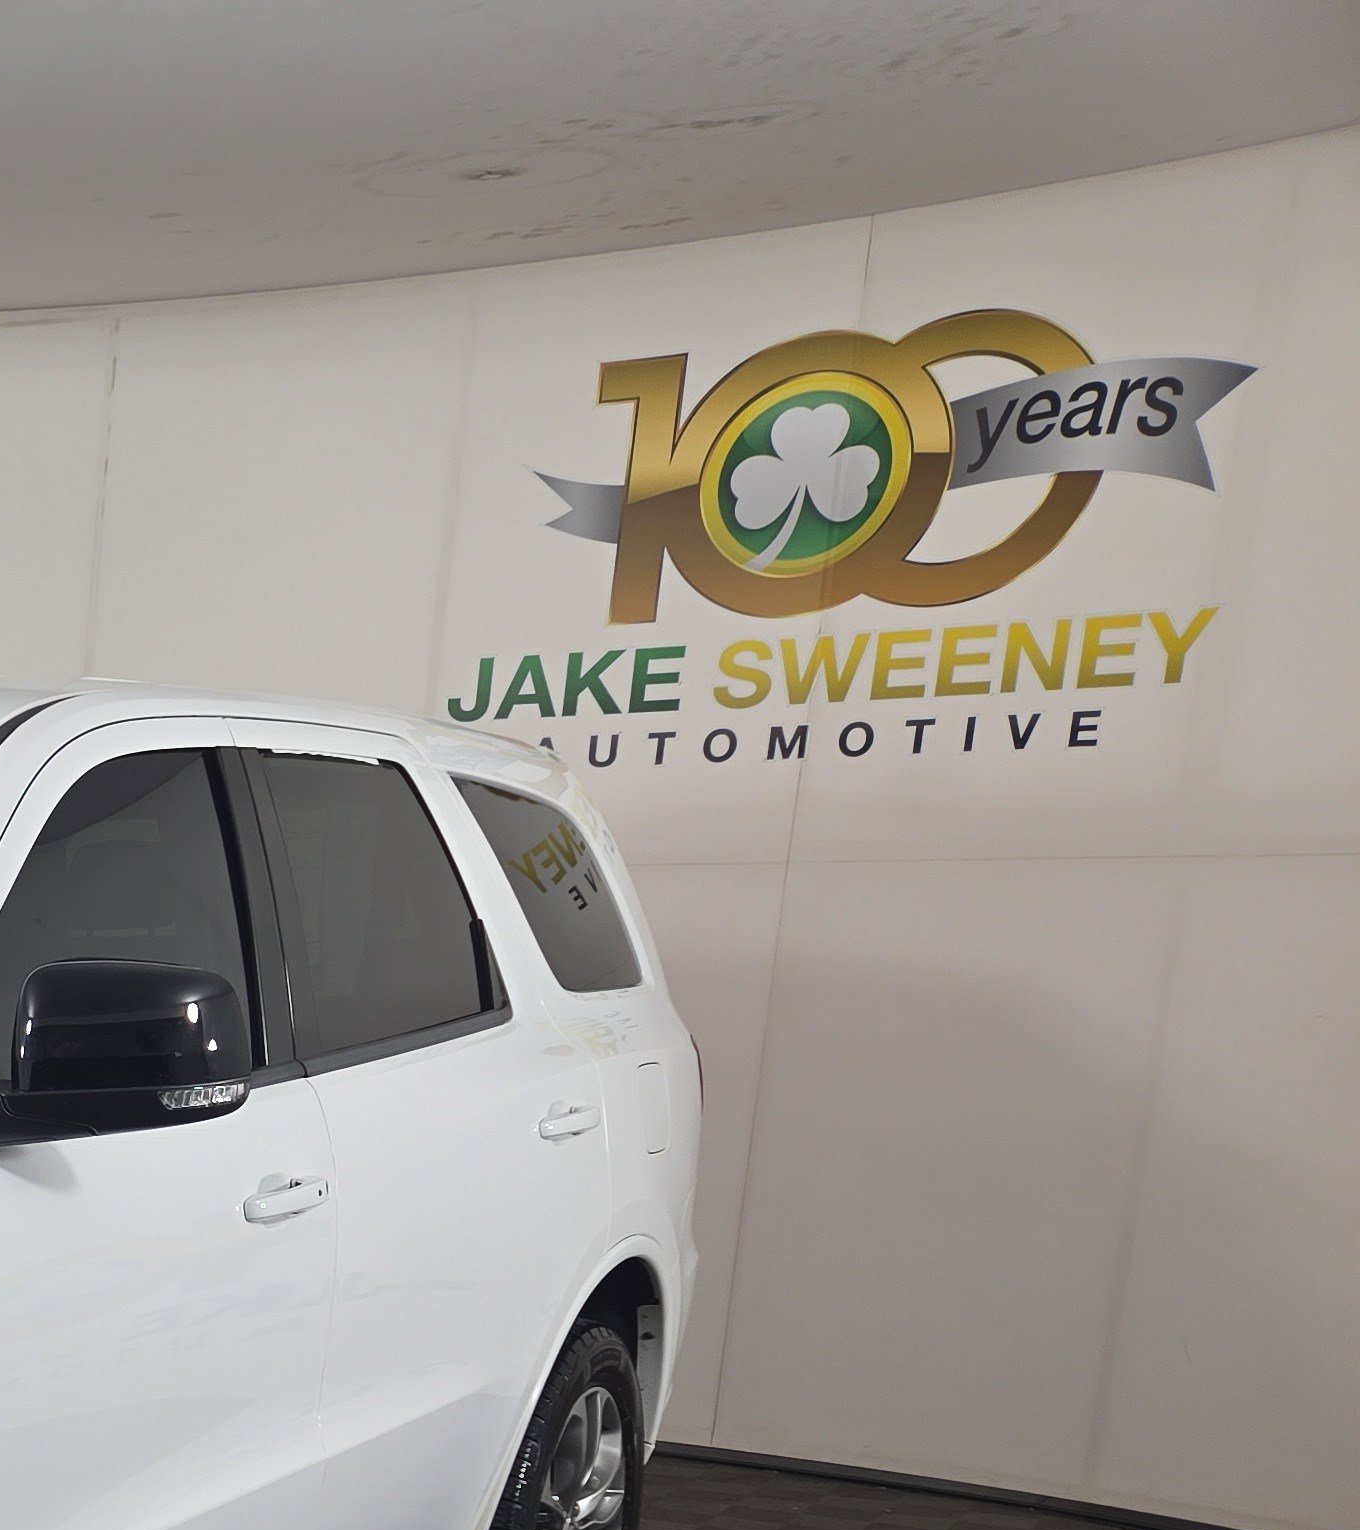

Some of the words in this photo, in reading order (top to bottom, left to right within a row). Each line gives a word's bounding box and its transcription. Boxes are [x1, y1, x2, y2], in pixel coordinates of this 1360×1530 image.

[966, 374, 1184, 474] years
[447, 646, 686, 722] JAKE
[711, 606, 1219, 710] SWEENEY
